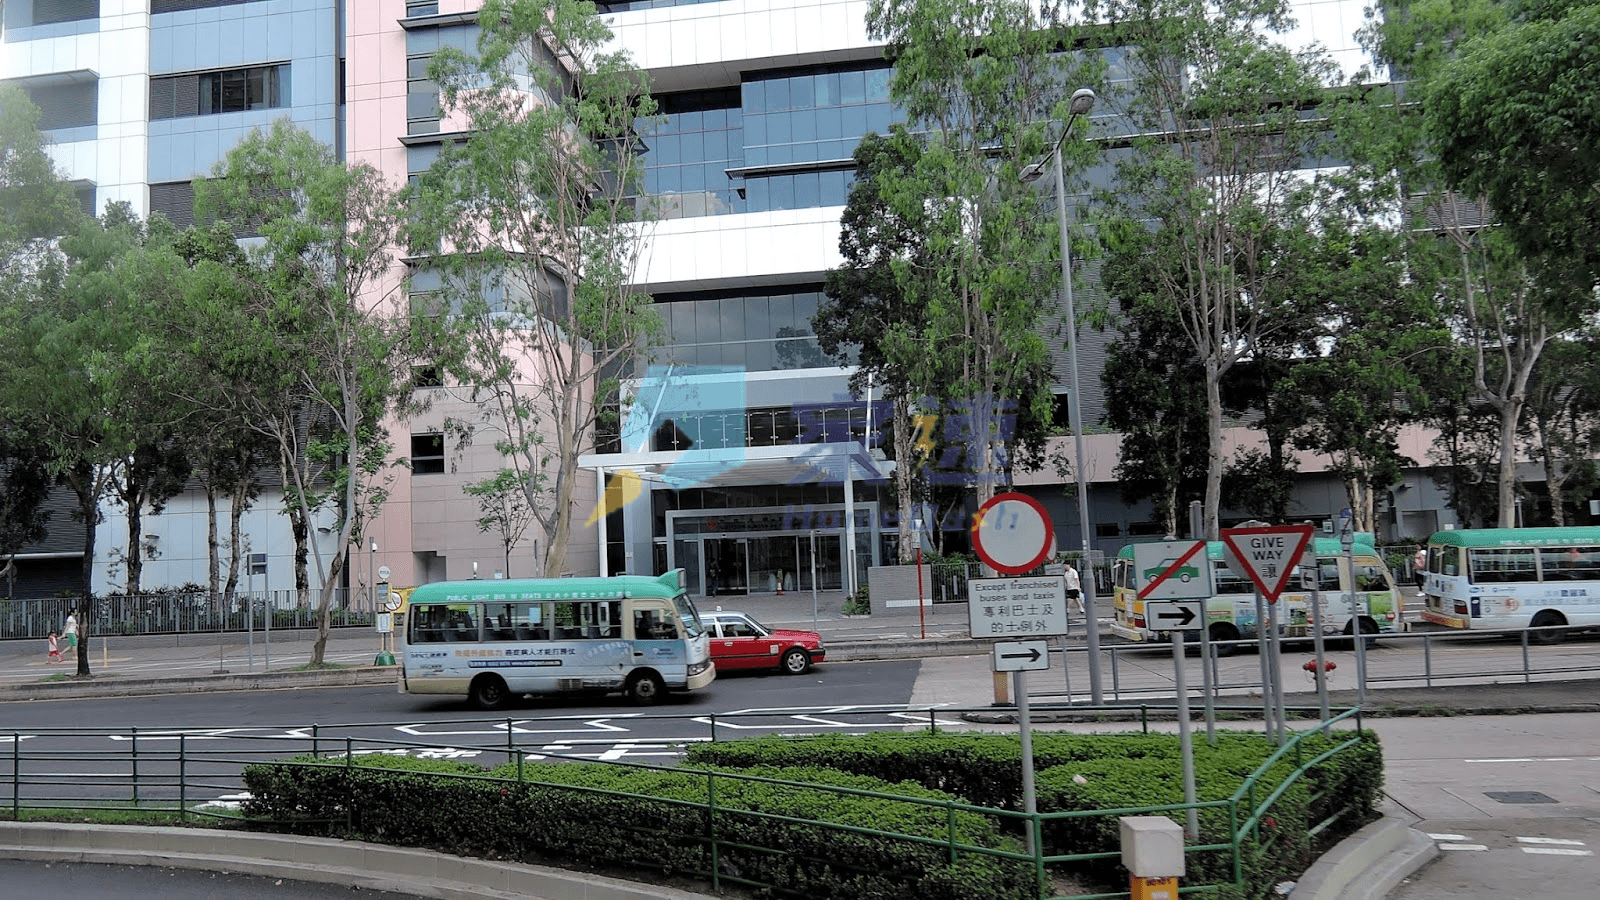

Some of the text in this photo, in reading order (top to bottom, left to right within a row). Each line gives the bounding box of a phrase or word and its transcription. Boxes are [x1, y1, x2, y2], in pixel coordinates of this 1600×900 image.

[1251, 537, 1284, 548] GIVE
[1252, 550, 1283, 560] WAY
[1261, 563, 1278, 578] 讓
[975, 581, 1059, 592] Except franchised
[980, 594, 1007, 602] buses
[1033, 592, 1055, 600] taxis
[983, 604, 1054, 618] 專利巴士及
[991, 620, 1047, 633] 的士例外
